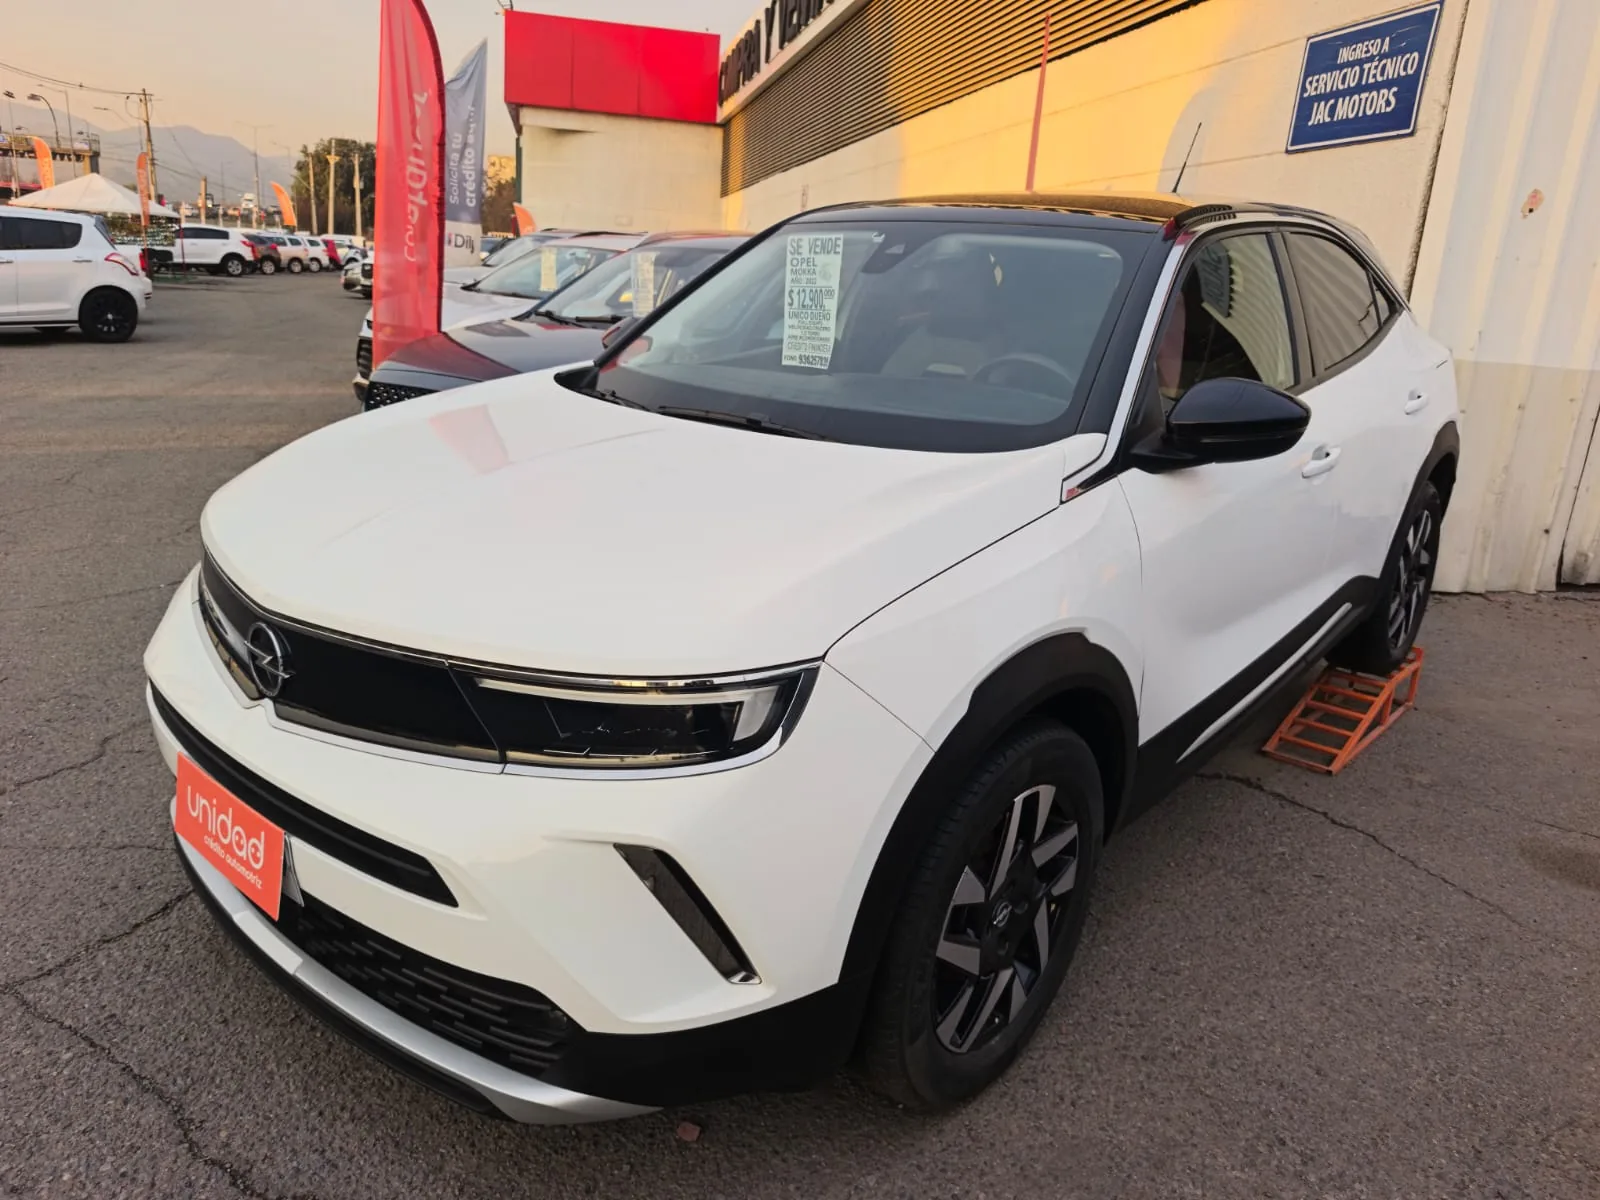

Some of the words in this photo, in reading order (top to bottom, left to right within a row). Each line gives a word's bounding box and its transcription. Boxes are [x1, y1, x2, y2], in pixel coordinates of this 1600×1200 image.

[719, 19, 761, 107] COMPRA
[765, 0, 777, 63] Y
[1337, 38, 1381, 64] INGRESO
[1381, 36, 1390, 54] A
[1303, 65, 1361, 98] SERVICIO
[1361, 51, 1419, 86] TÉCNICO
[1308, 98, 1336, 126] JAC
[1333, 87, 1399, 122] MOTORS
[450, 131, 462, 149] tu
[448, 152, 460, 205] Solicita
[460, 147, 477, 208] crédito
[789, 238, 803, 256] SE
[808, 236, 841, 255] VENDE
[790, 257, 817, 268] OPEL
[790, 268, 817, 276] MOKKA
[788, 288, 794, 307] $
[187, 784, 265, 870] unidad
[225, 854, 262, 890] automotriz
